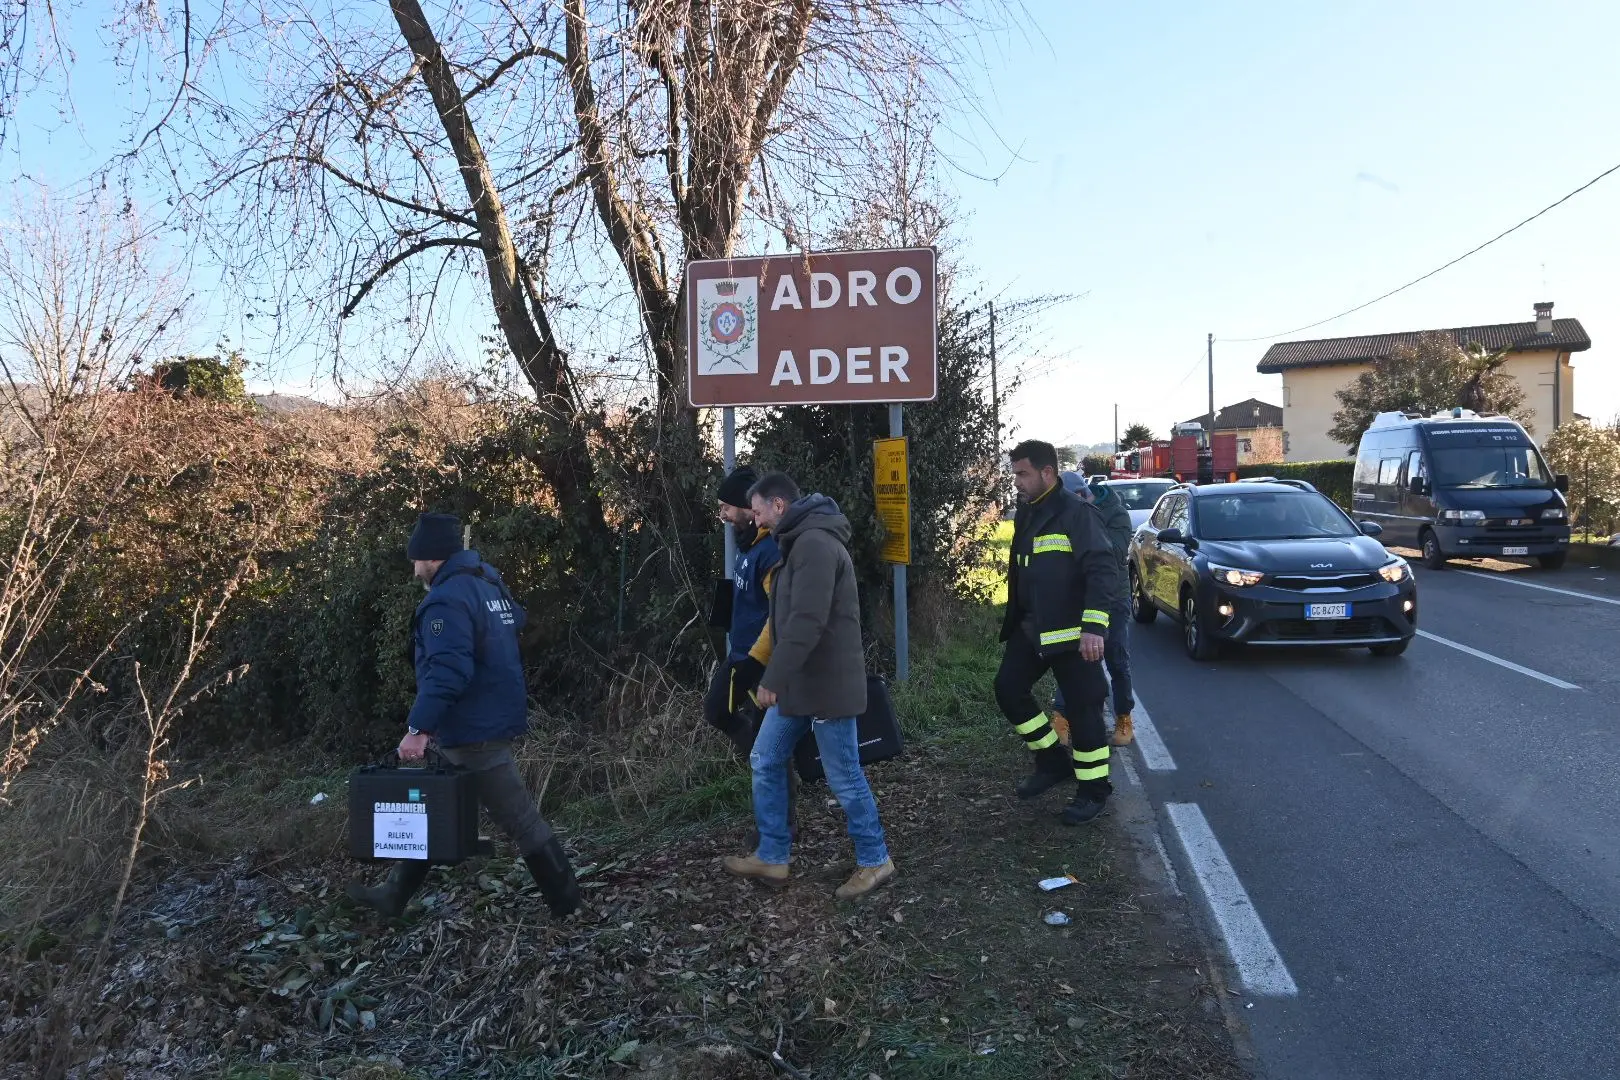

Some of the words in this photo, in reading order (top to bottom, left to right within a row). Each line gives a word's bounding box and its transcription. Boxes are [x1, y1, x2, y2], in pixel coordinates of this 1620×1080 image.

[770, 266, 922, 311] ADRO
[770, 346, 911, 386] ADER
[374, 802, 426, 813] CARABINIERI
[387, 831, 414, 840] RILIEVI
[374, 842, 427, 852] PLANIMETRICI
